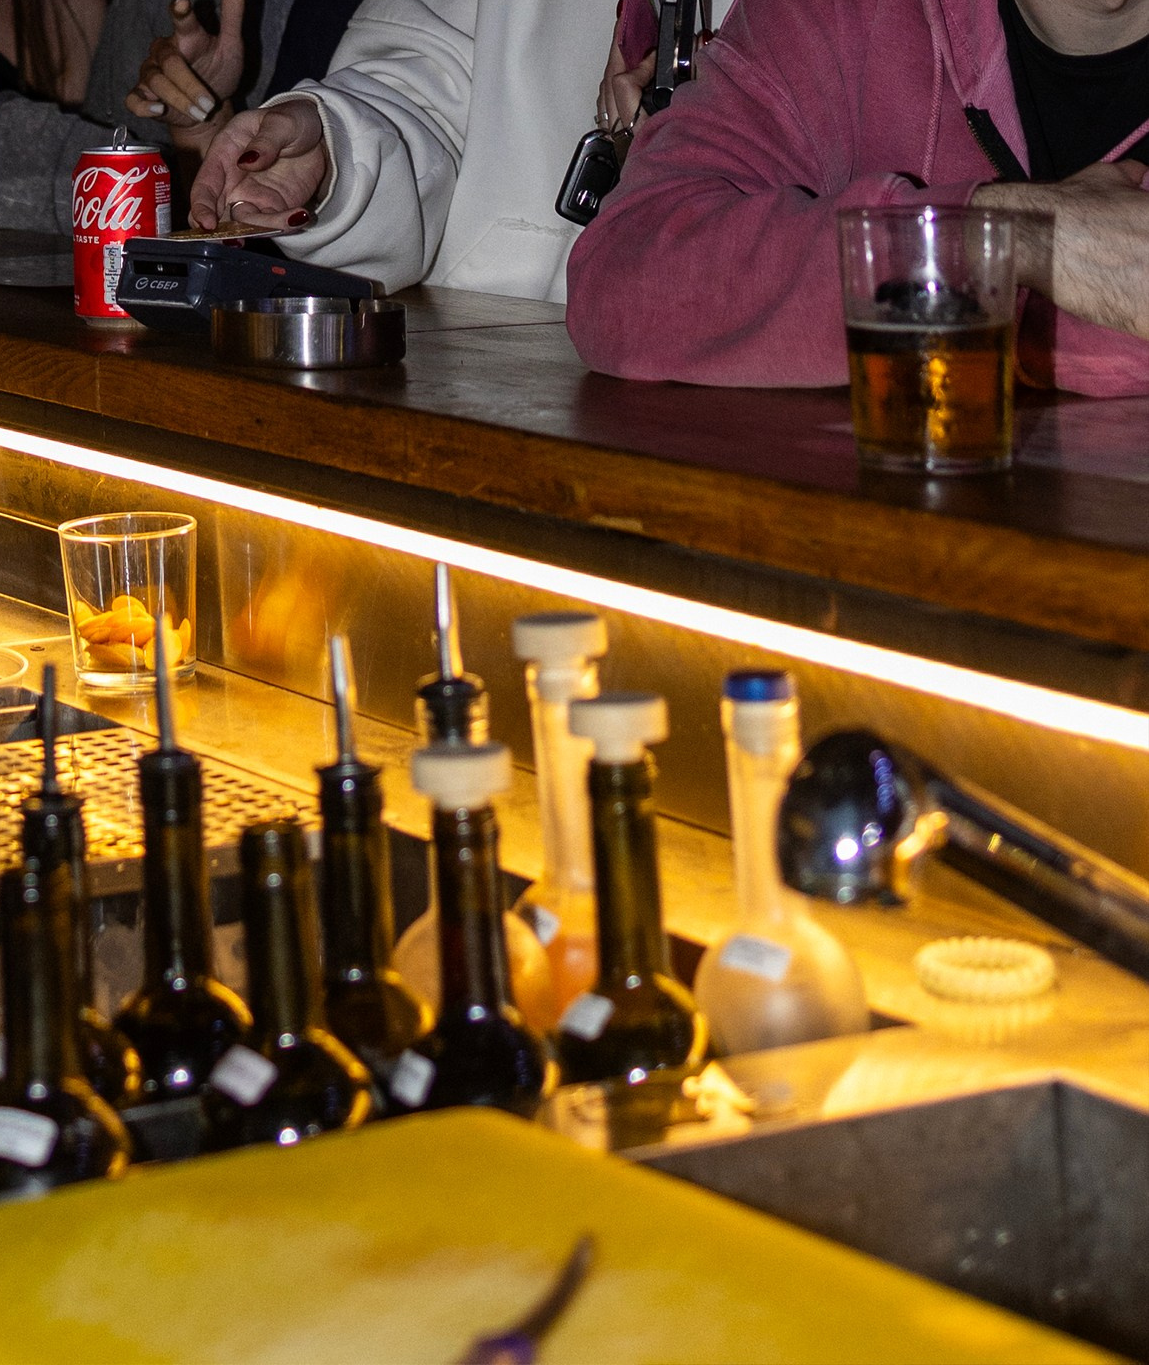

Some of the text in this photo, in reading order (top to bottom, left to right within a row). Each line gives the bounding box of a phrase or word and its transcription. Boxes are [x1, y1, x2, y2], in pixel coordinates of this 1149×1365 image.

[72, 166, 149, 230] Cola
[76, 235, 100, 244] TASTE
[149, 279, 179, 290] СБЕР
